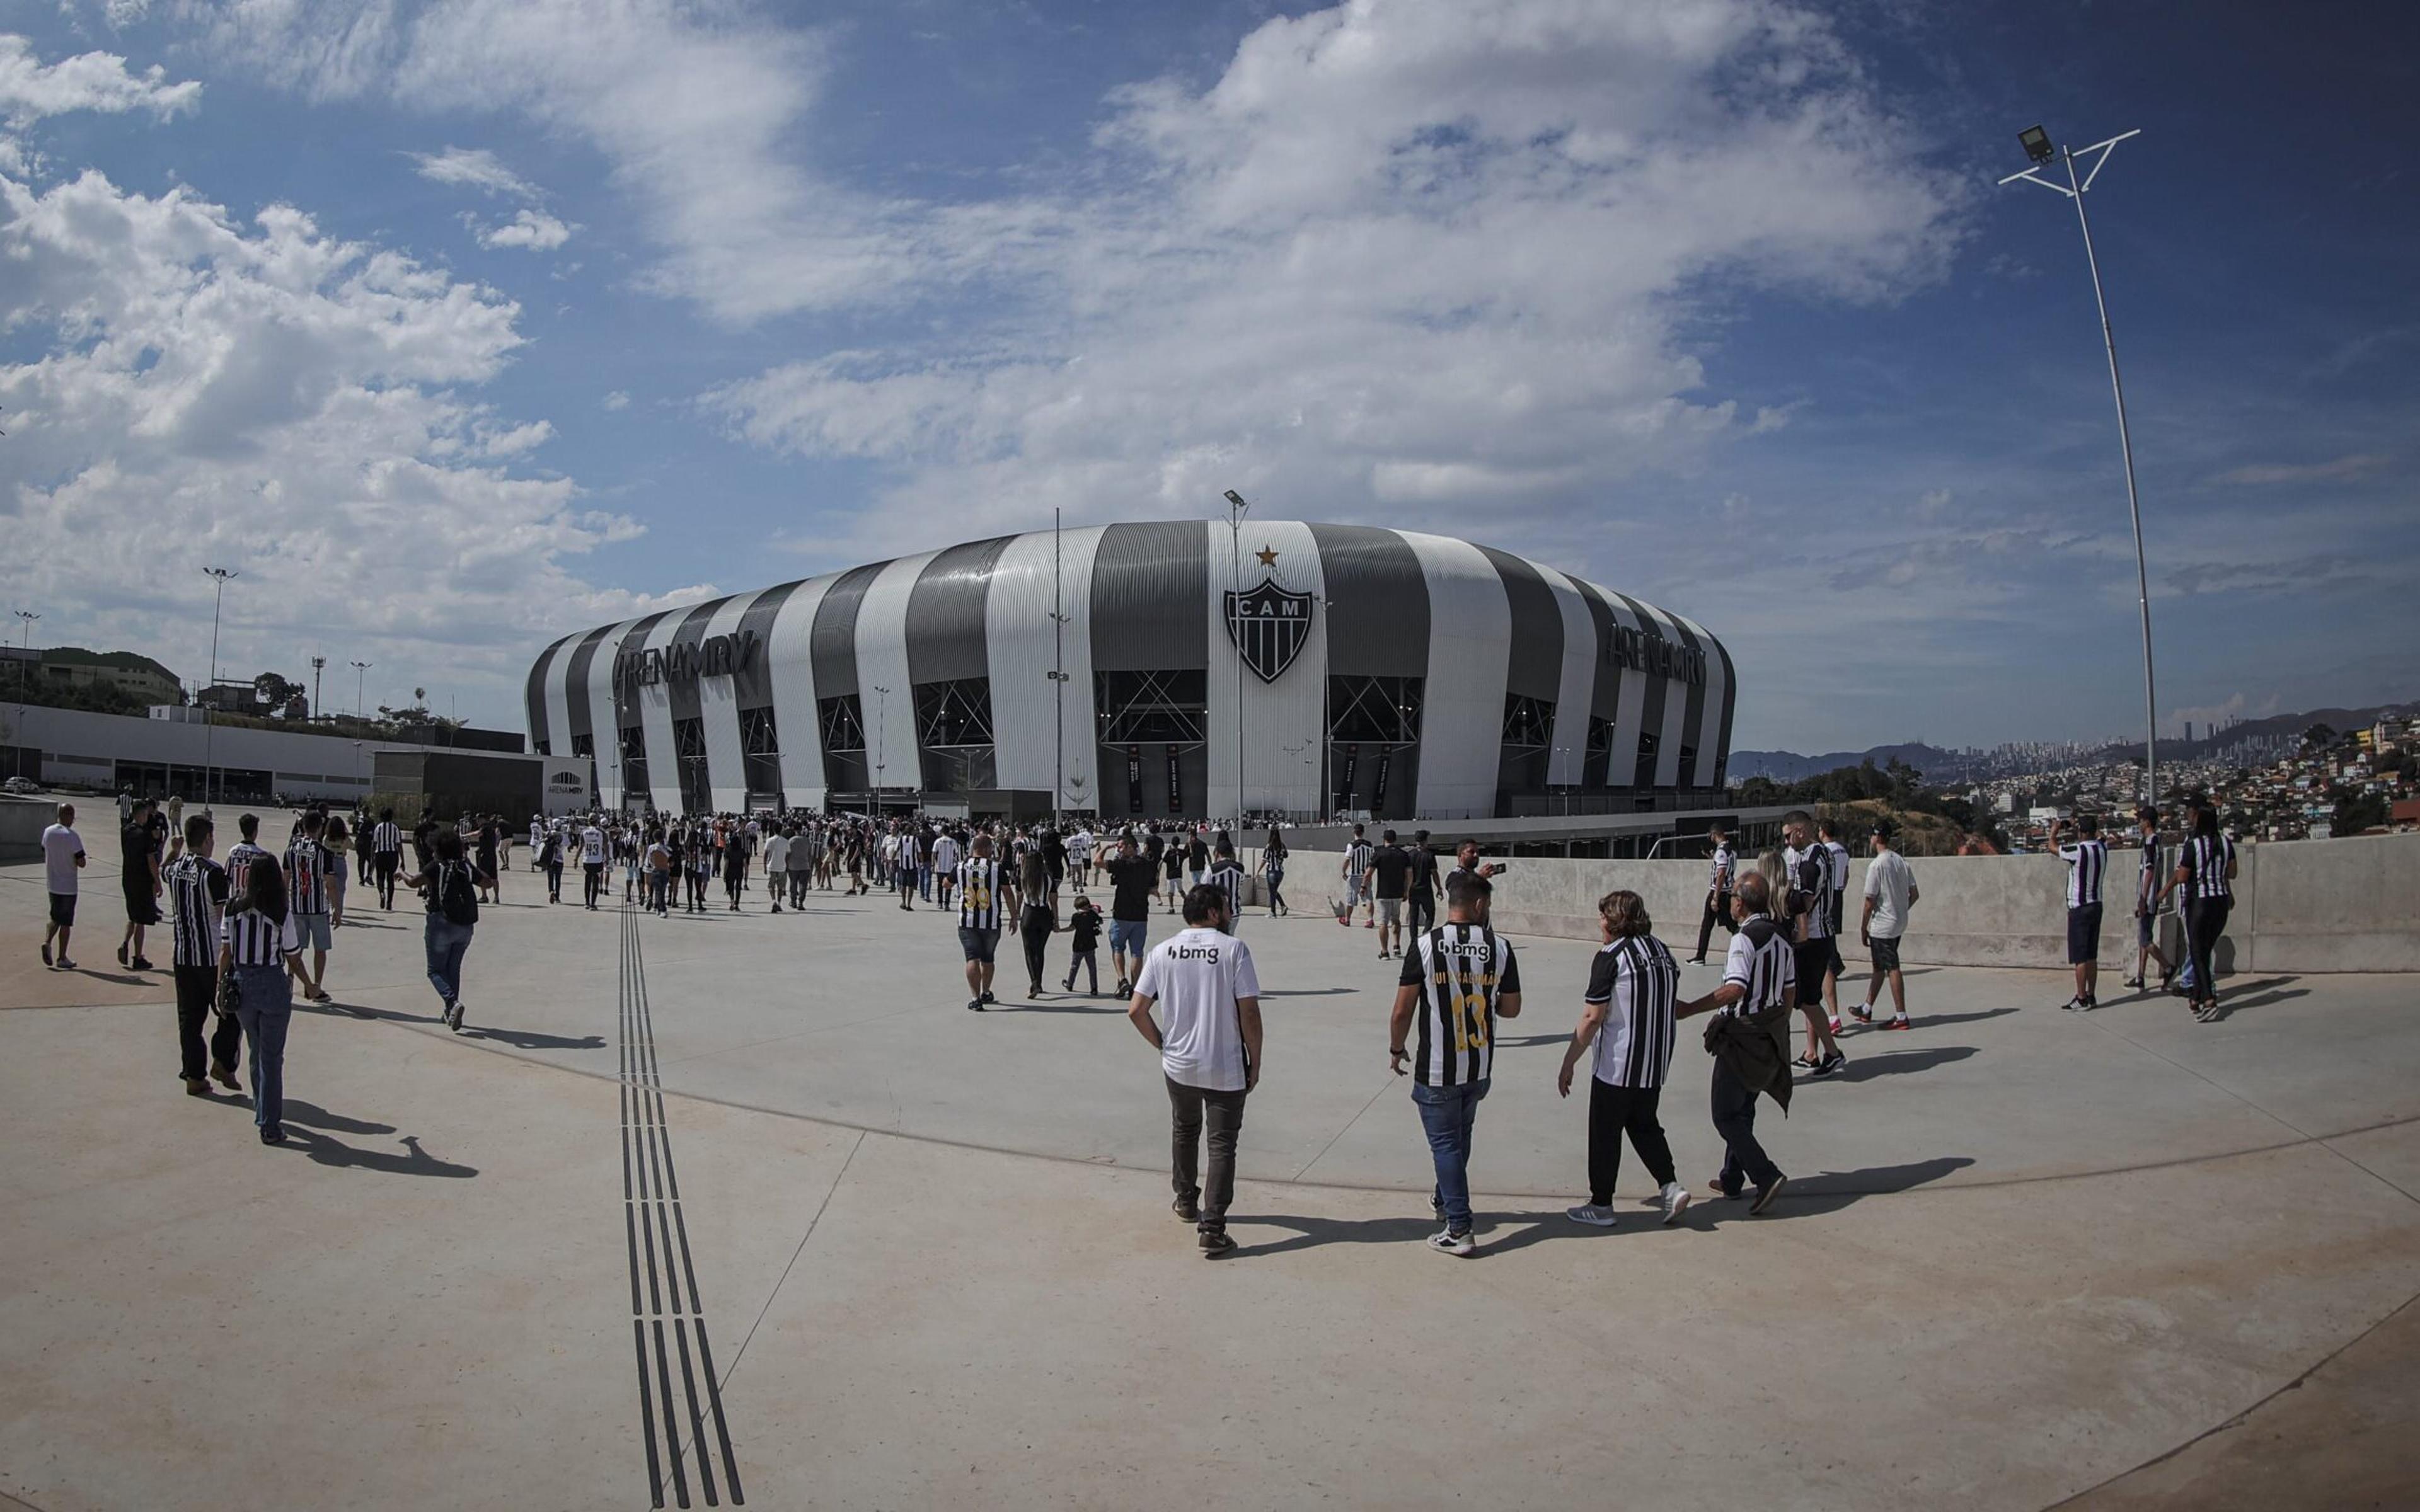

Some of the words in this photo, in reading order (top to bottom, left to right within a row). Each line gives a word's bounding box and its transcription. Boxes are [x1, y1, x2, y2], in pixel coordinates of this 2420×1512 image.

[177, 866, 198, 884] bmg
[970, 864, 988, 874] bmg
[1179, 945, 1219, 965] bmg
[1452, 940, 1489, 961] bmg
[1452, 994, 1489, 1053] 13
